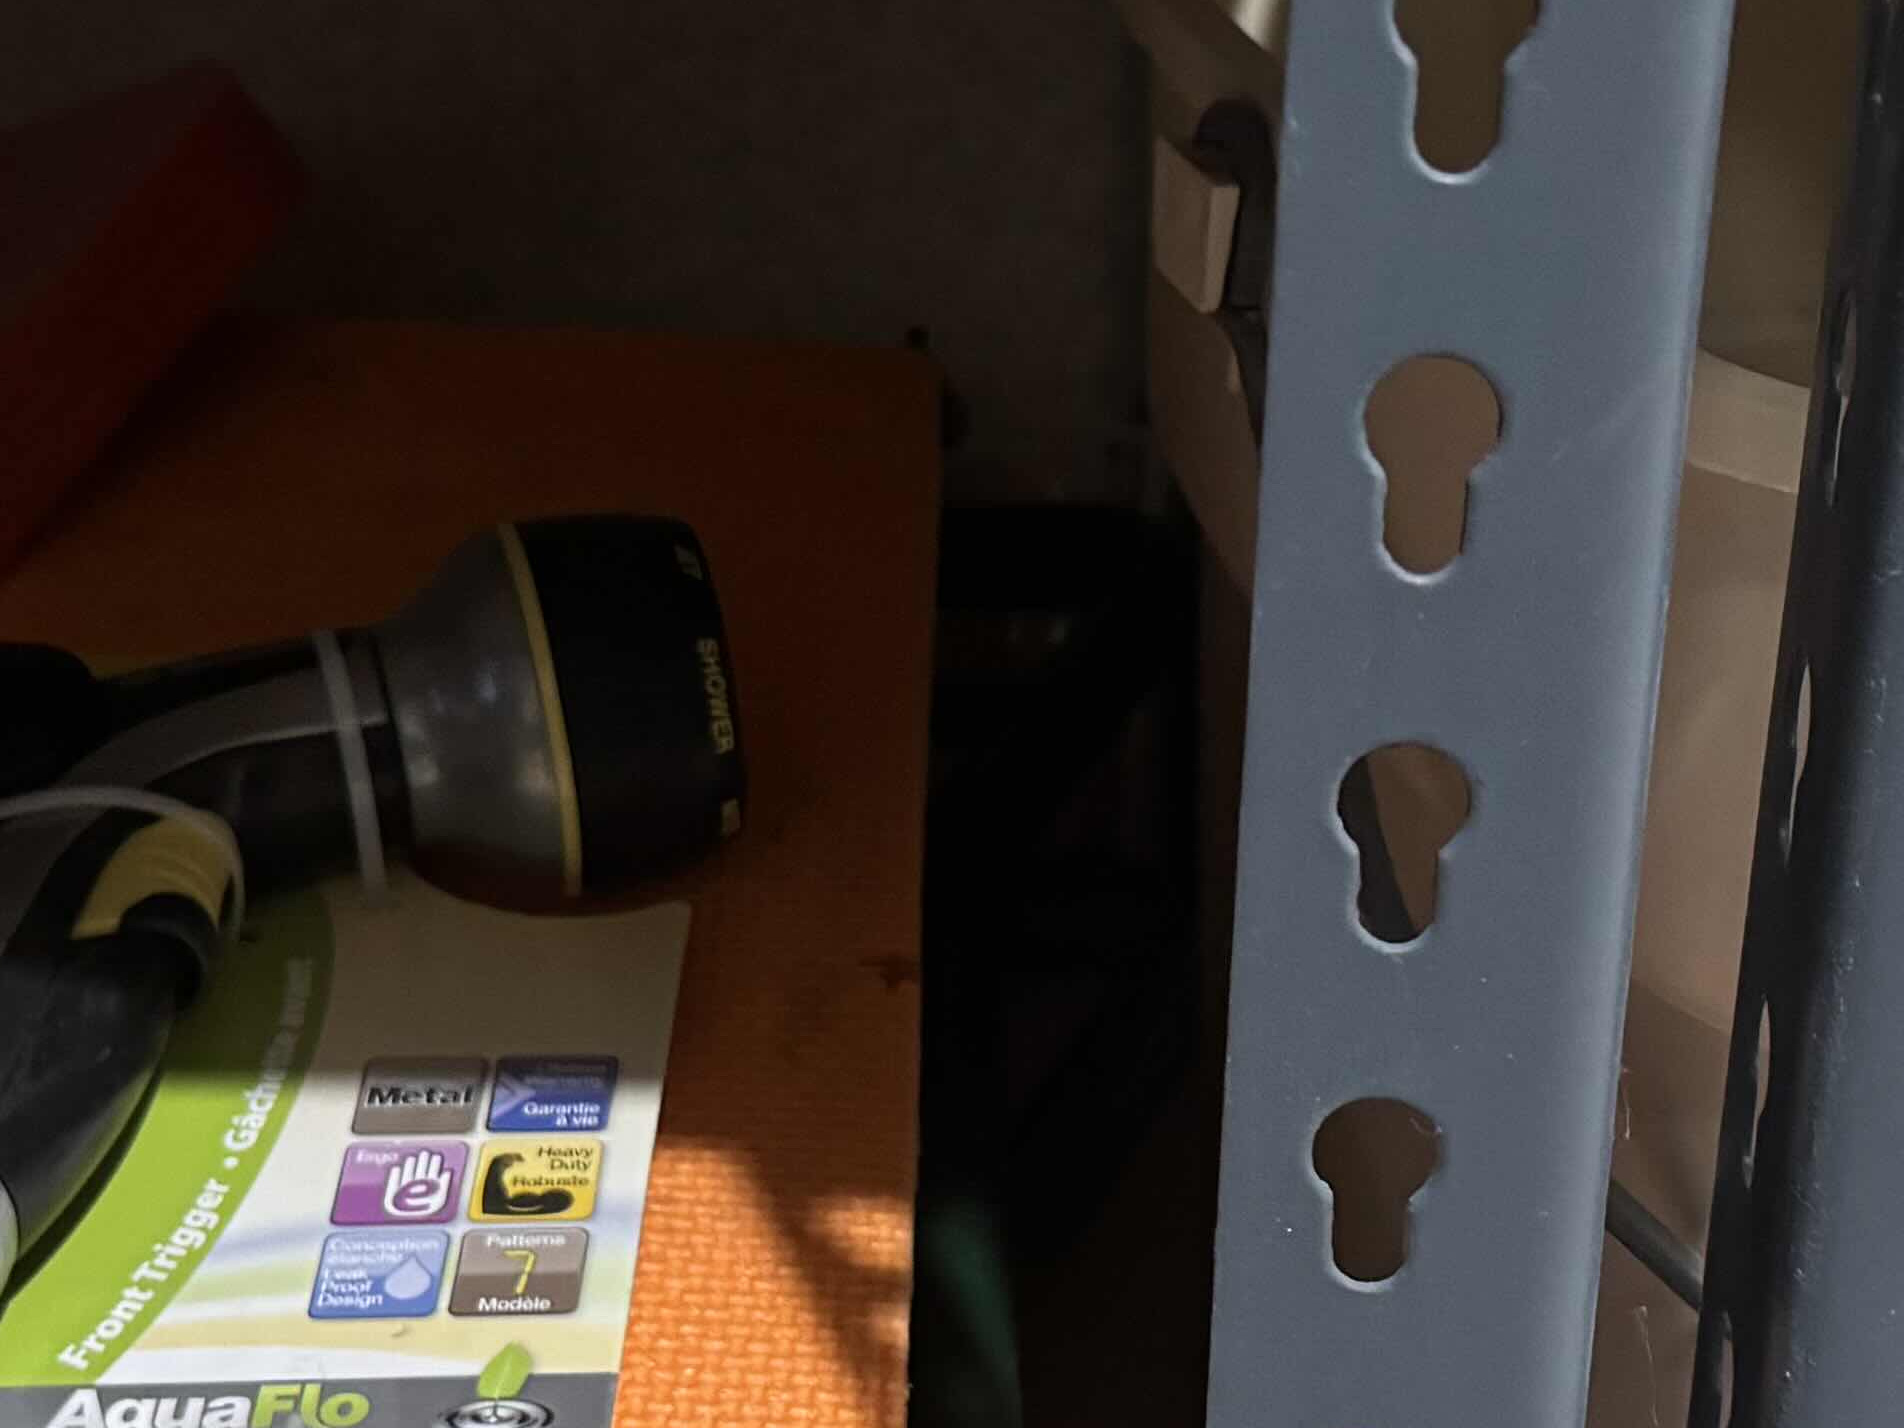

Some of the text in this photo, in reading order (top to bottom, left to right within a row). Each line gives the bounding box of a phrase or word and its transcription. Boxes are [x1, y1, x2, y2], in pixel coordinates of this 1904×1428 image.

[696, 636, 736, 756] SHOWER
[366, 1084, 475, 1106] Metal
[522, 1102, 601, 1116] Garantie
[572, 1115, 600, 1127] vie
[355, 1149, 399, 1166] Ergo
[536, 1146, 594, 1160] Heavy
[548, 1159, 593, 1172] Duty
[511, 1174, 590, 1188] Robuste
[328, 1238, 440, 1254] Conception
[485, 1233, 567, 1248] Patterns
[56, 1283, 157, 1371] Front
[136, 1175, 233, 1286] Trigger
[323, 1268, 369, 1280] Leak
[503, 1249, 538, 1295] 7
[320, 1280, 374, 1294] Proof
[316, 1293, 385, 1310] Design
[477, 1295, 553, 1312] Modèle
